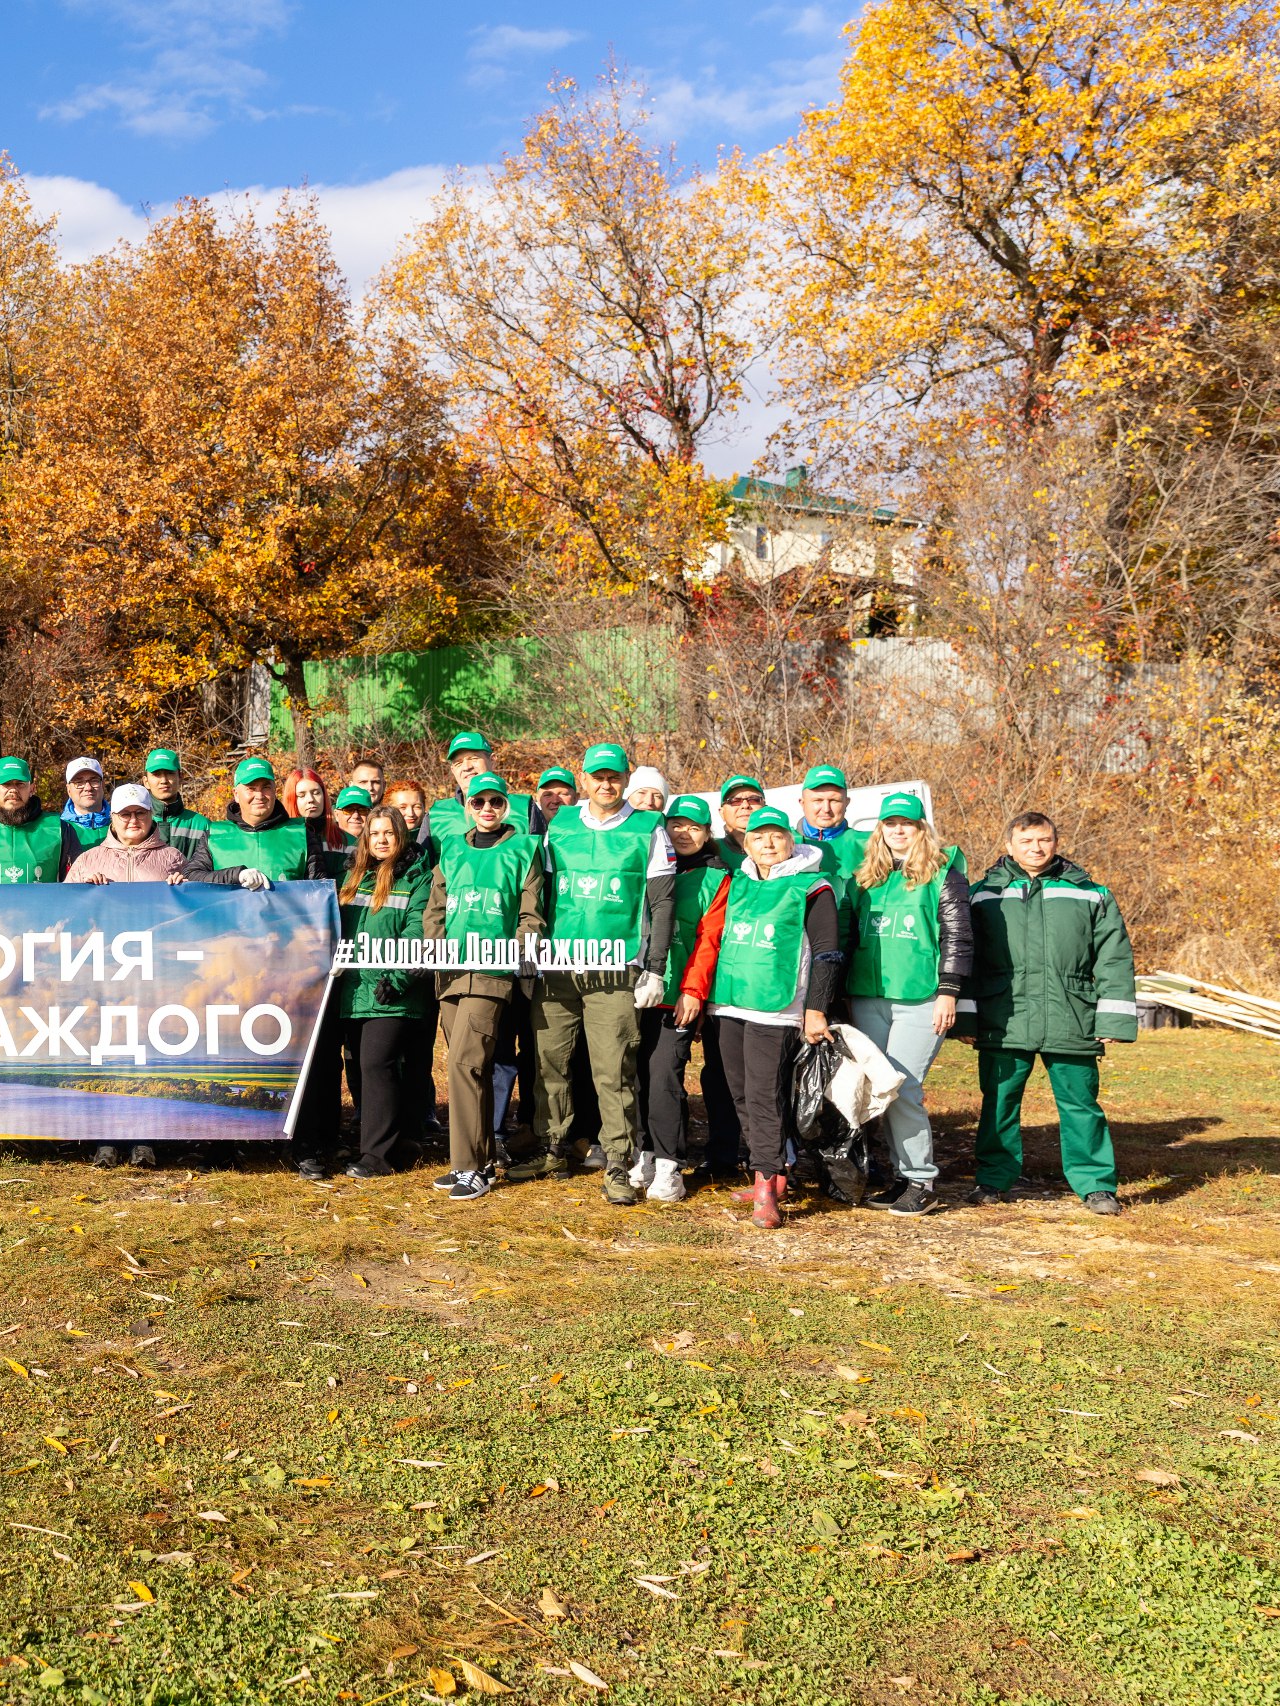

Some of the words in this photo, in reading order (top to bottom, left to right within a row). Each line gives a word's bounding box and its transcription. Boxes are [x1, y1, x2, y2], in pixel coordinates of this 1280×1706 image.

[334, 932, 459, 966] #Экология
[466, 932, 519, 969] Дело
[524, 932, 626, 974] Каждого
